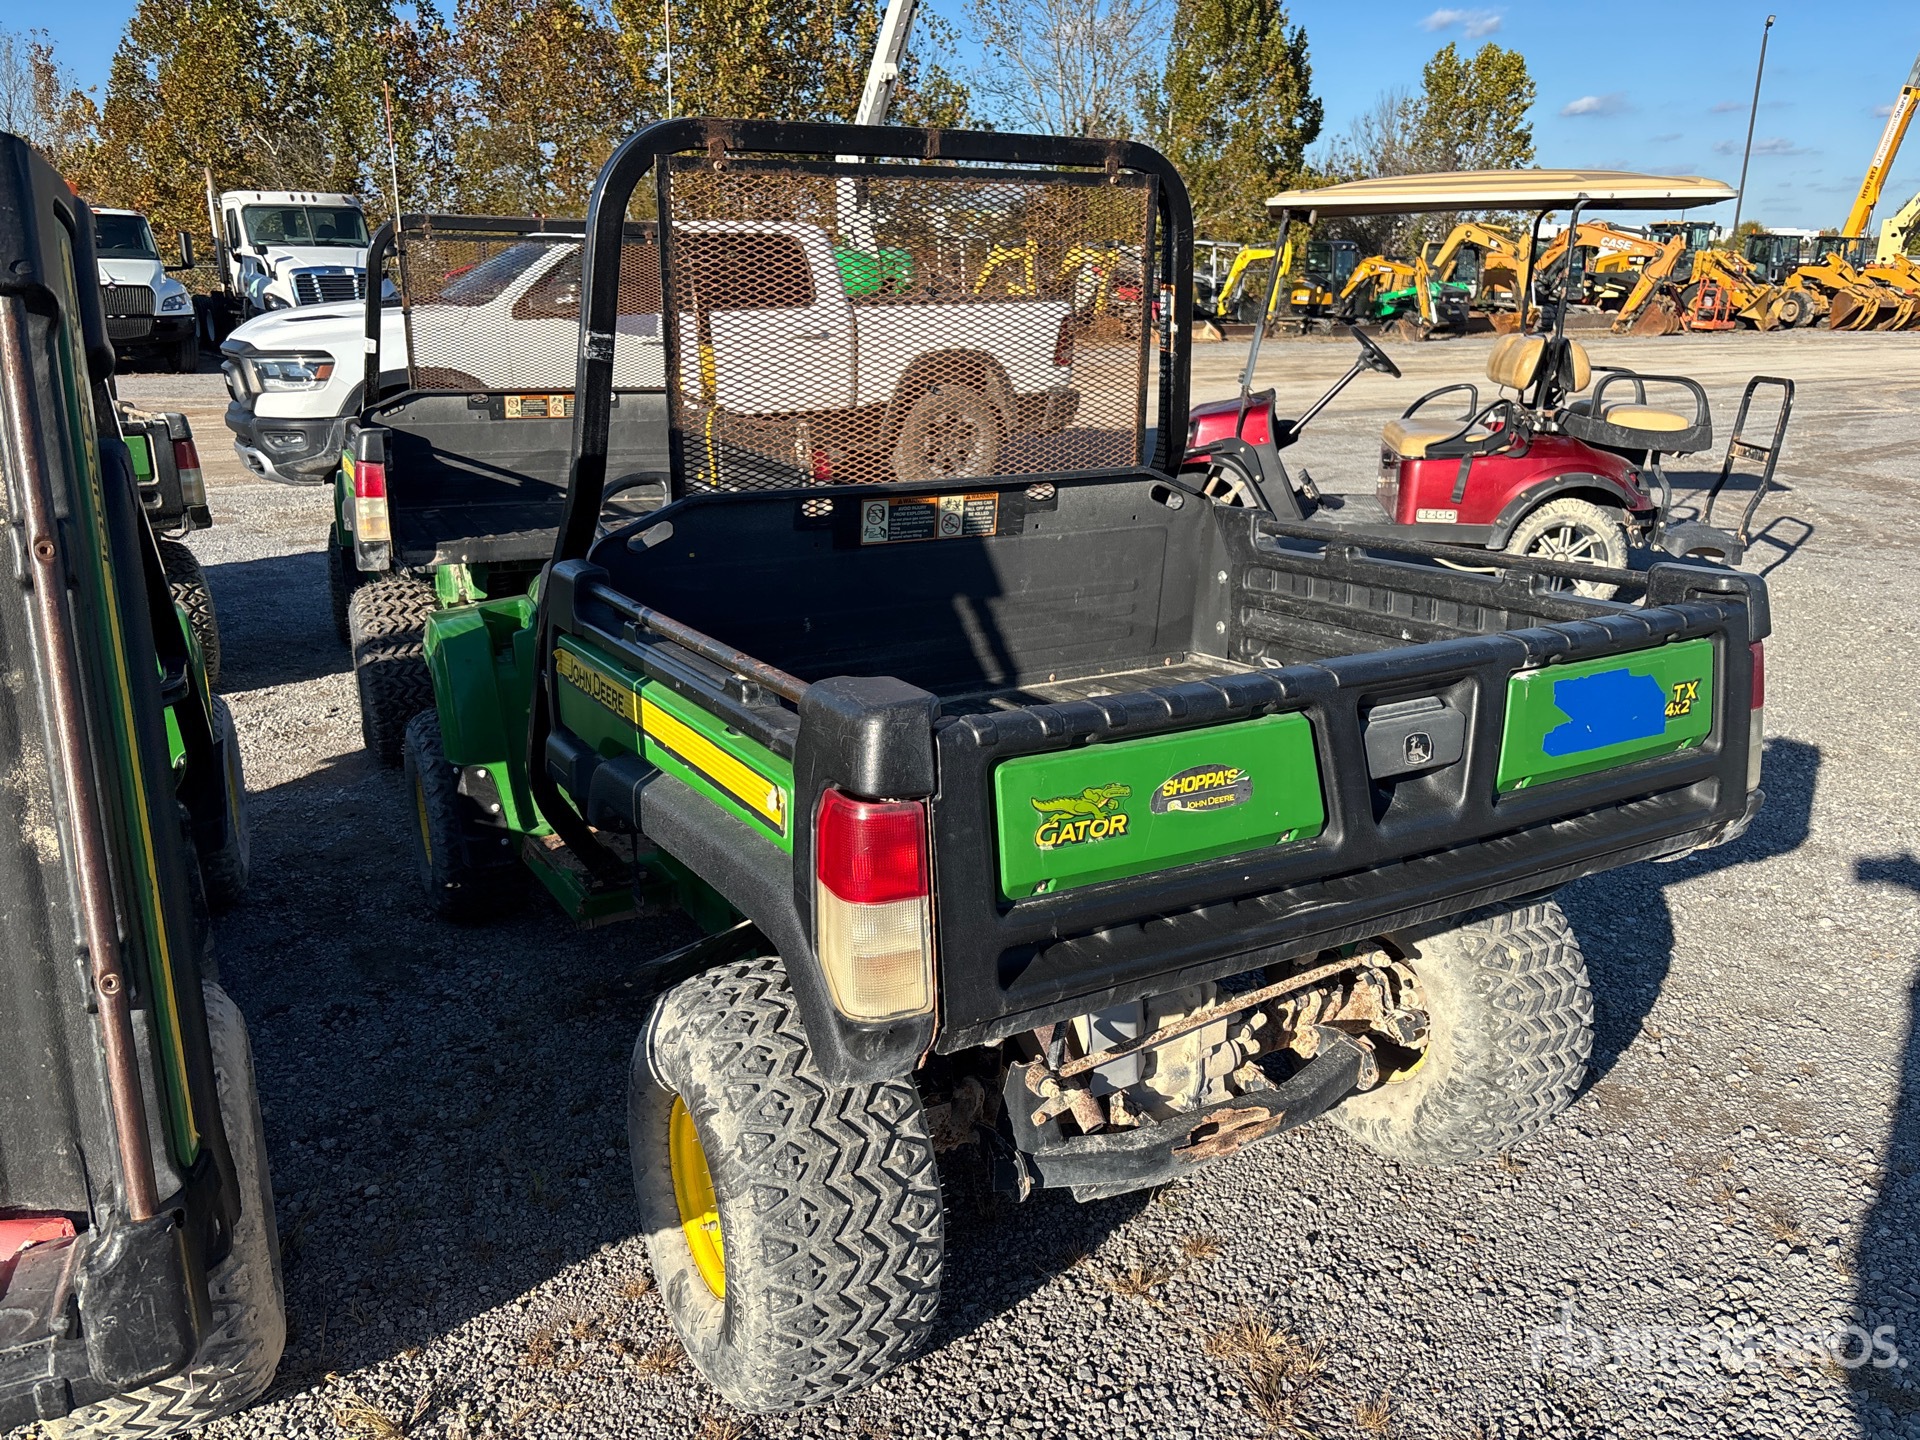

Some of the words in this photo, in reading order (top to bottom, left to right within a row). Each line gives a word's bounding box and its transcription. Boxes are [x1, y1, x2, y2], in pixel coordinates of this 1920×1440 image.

[1878, 96, 1908, 158] EquipmentShare
[1600, 237, 1633, 250] CASE
[568, 658, 592, 695] JOHN
[593, 672, 625, 716] DEERE
[1673, 680, 1699, 703] TX
[1664, 699, 1690, 717] 4x2
[1162, 768, 1239, 798] SHOPPA'S
[1185, 799, 1208, 810] JOHN
[1208, 793, 1235, 806] DEERE
[1035, 813, 1129, 848] GATOR
